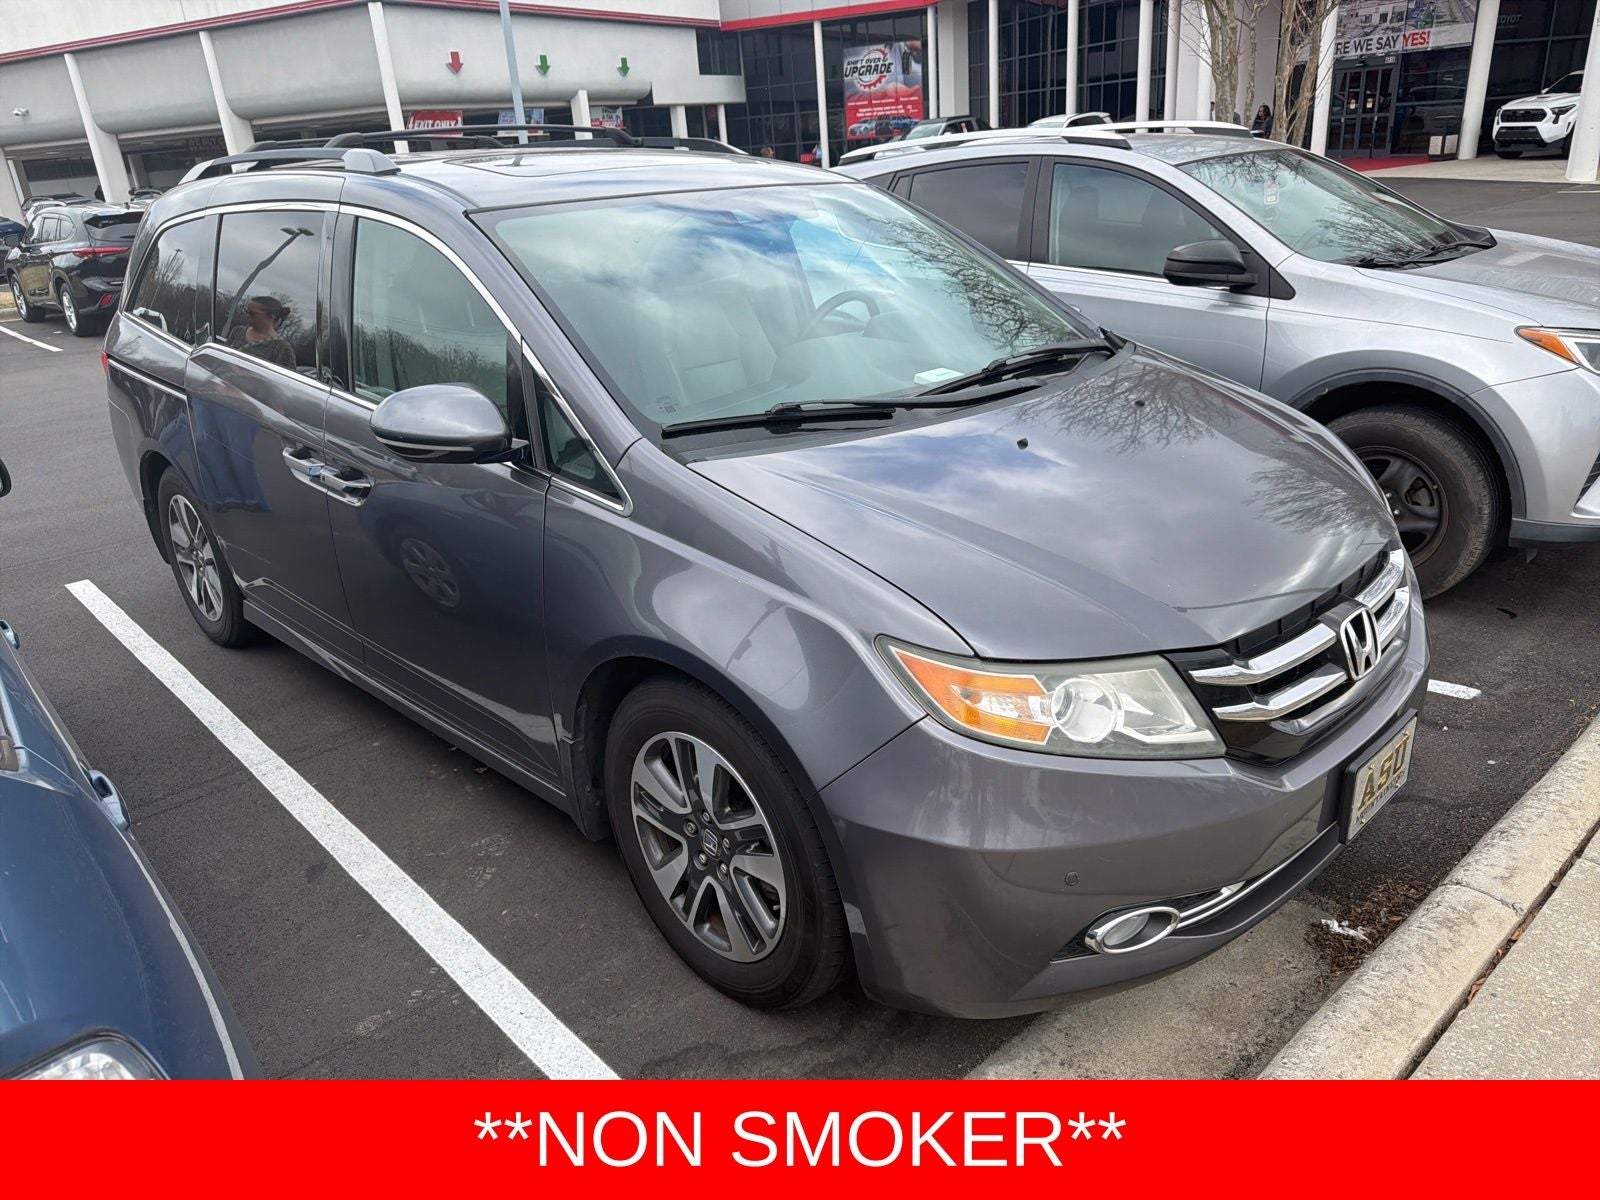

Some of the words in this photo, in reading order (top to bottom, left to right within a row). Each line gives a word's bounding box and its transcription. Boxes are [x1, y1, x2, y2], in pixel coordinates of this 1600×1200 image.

[1354, 37, 1374, 53] WE
[1375, 35, 1400, 51] SAY
[1402, 30, 1431, 48] YES!
[846, 58, 865, 67] SHIFT
[865, 57, 881, 65] OVER
[844, 62, 894, 78] UPGRADE
[414, 119, 434, 130] EXIT
[434, 119, 456, 129] ONLY
